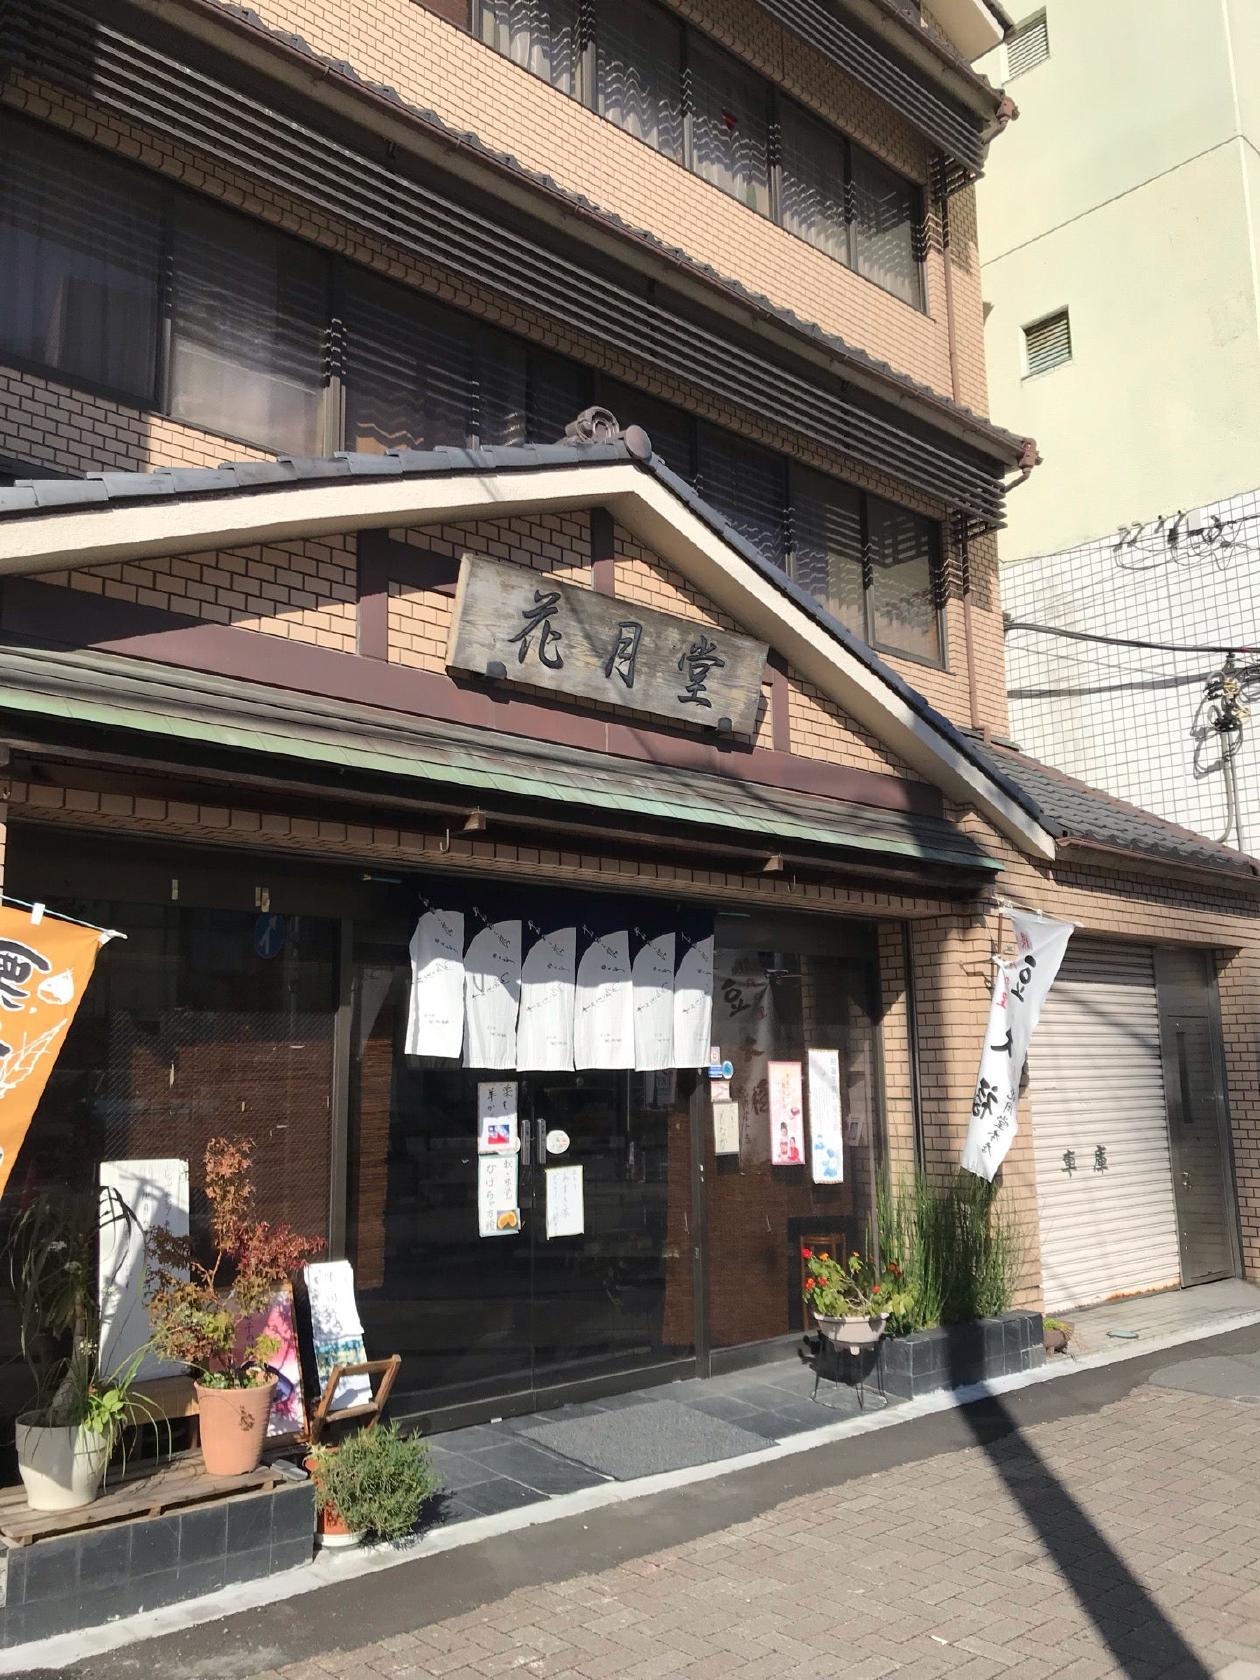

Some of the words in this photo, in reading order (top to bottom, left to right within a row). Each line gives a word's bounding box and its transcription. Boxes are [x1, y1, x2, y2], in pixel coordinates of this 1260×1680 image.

[507, 588, 726, 709] 花月堂
[1060, 1144, 1110, 1178] 車庫
